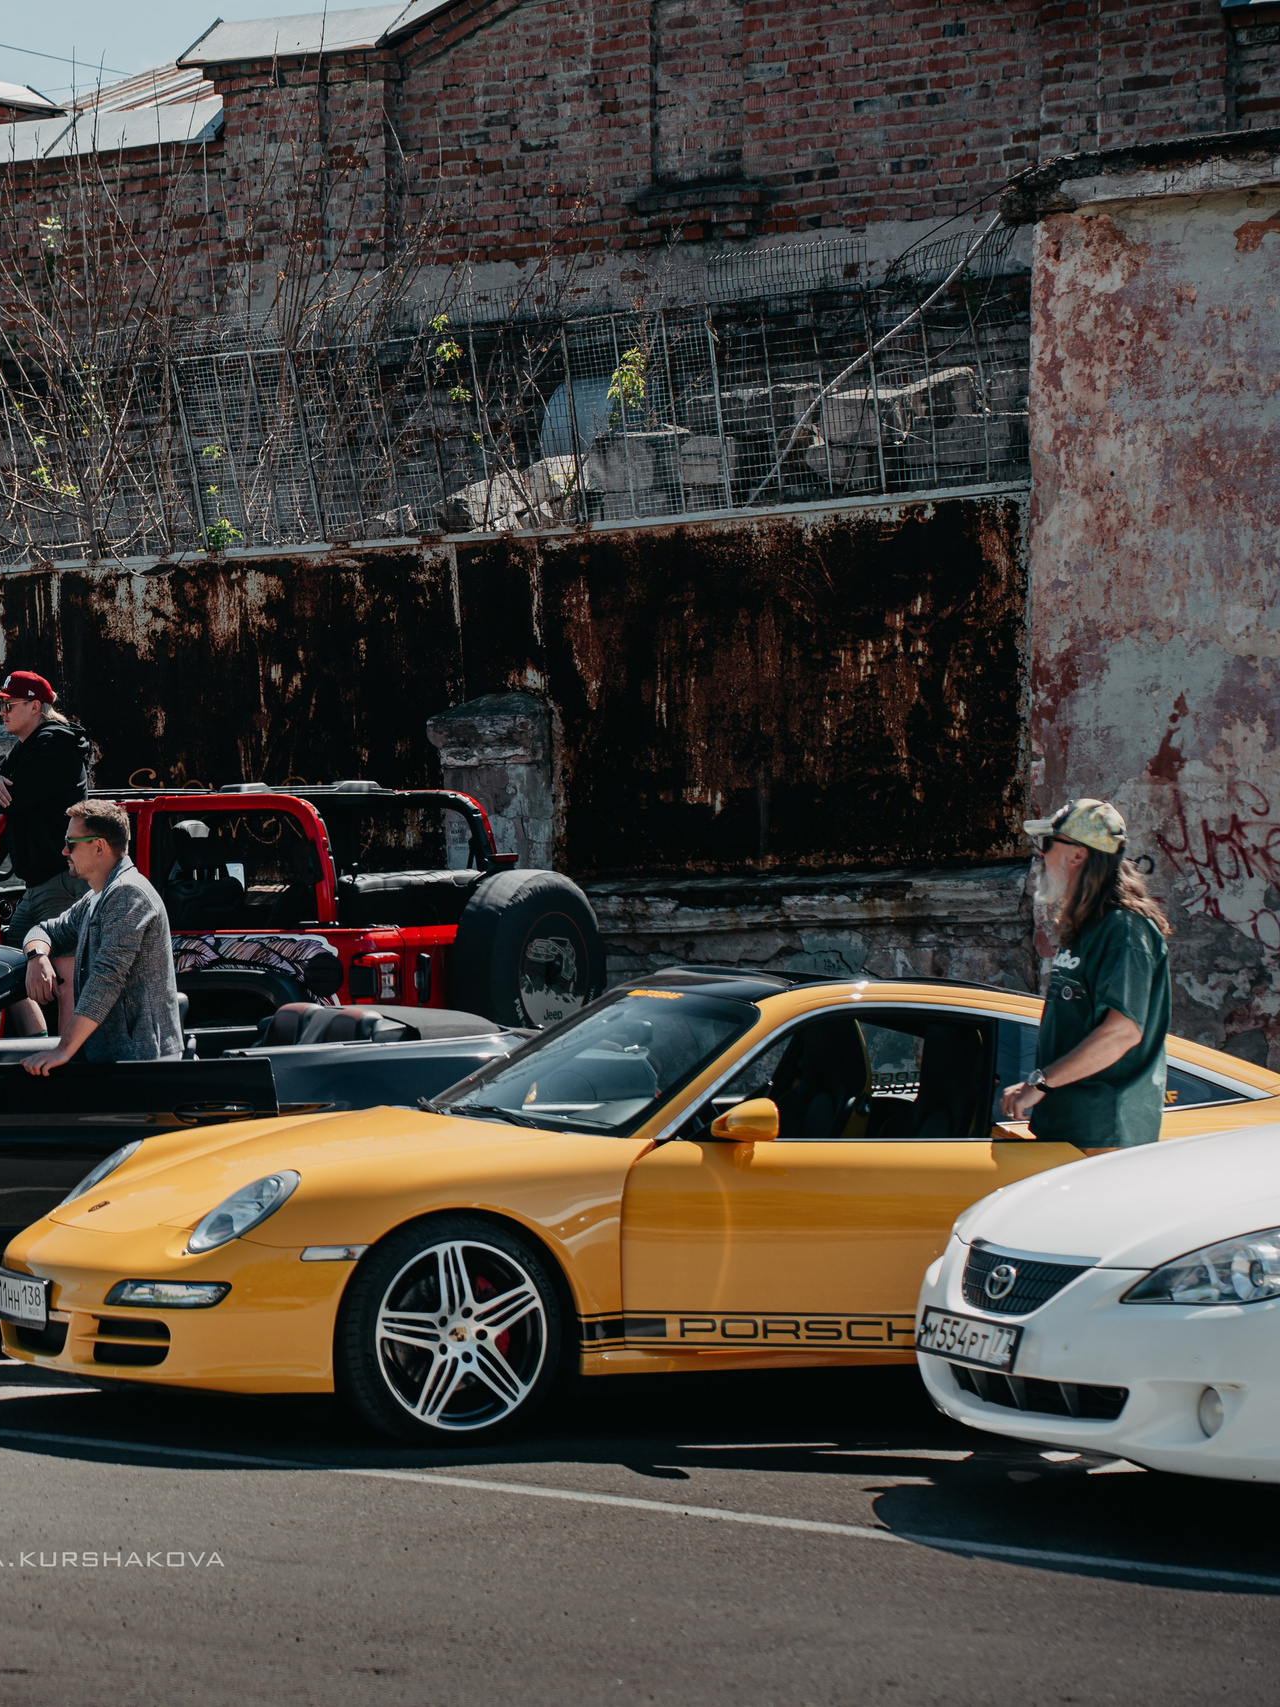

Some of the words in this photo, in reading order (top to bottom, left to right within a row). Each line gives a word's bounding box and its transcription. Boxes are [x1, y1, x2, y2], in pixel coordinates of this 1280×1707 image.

[544, 1008, 563, 1021] Jeep
[22, 1284, 41, 1307] 138
[679, 1318, 916, 1342] PORSCH
